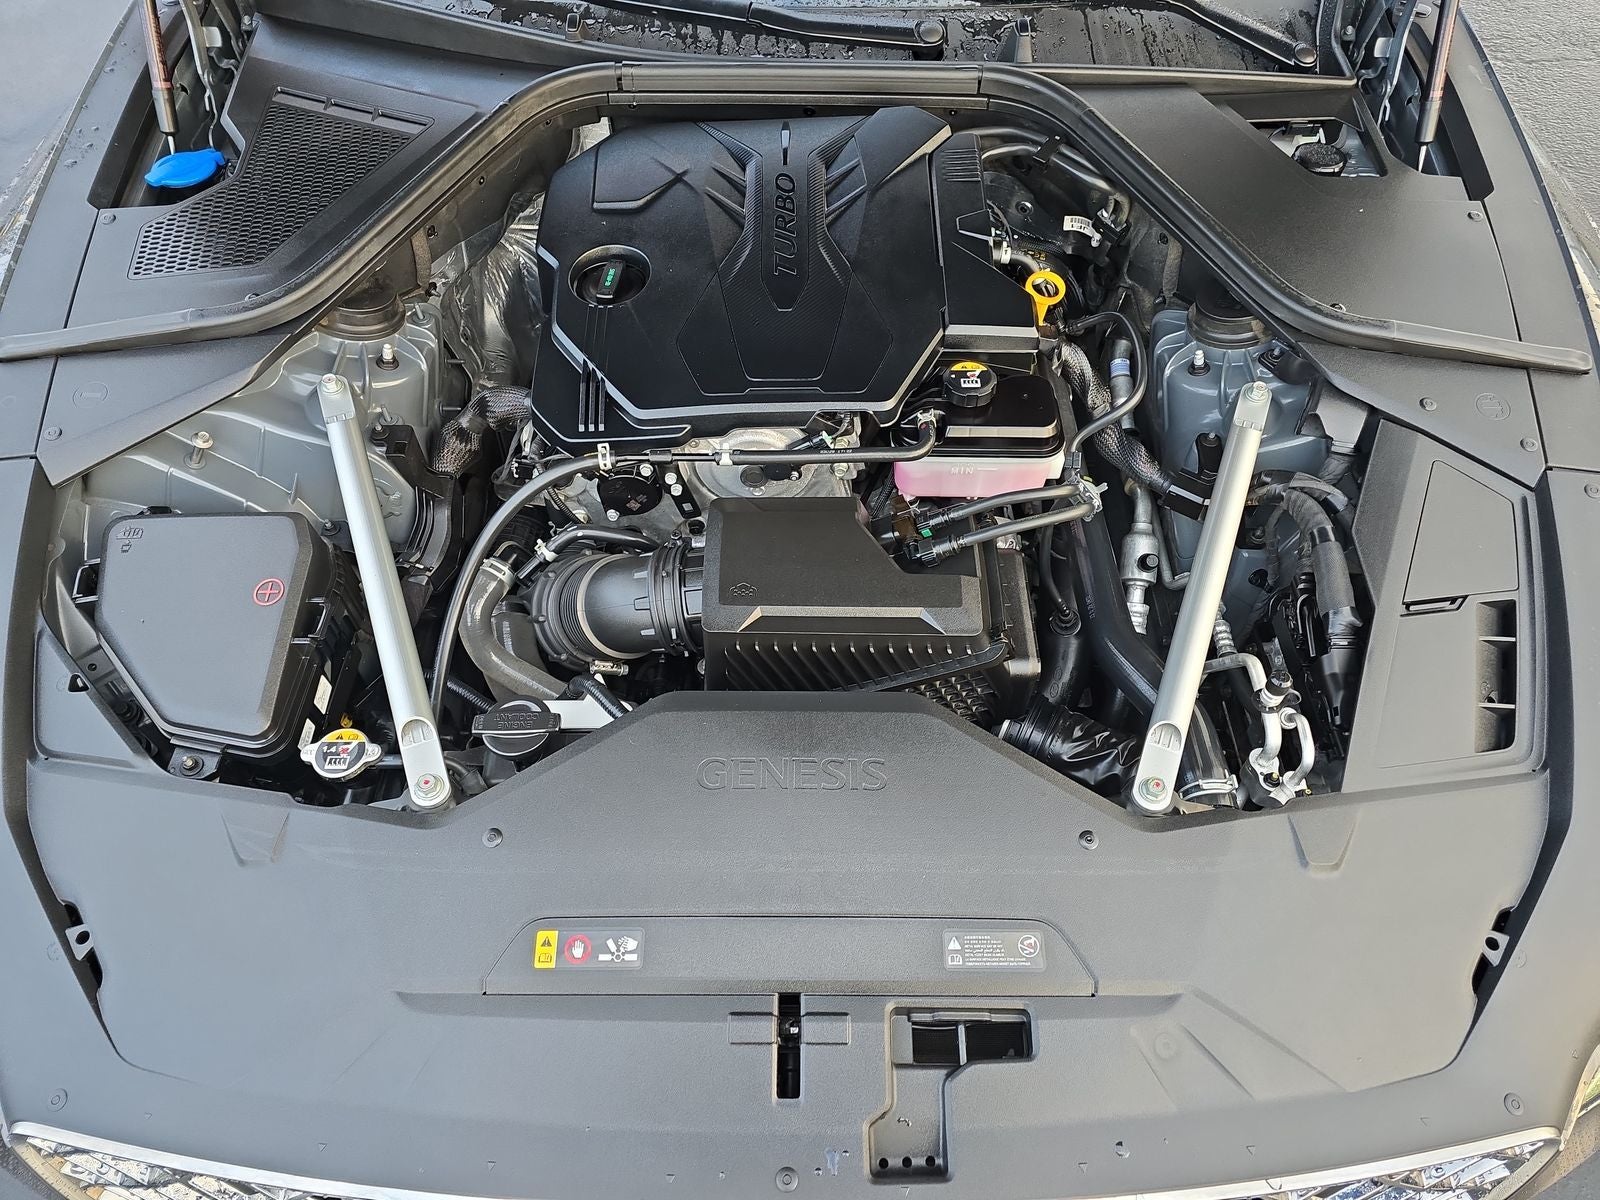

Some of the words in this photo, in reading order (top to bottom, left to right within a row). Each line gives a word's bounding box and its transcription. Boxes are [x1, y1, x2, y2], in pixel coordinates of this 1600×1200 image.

[774, 172, 797, 276] TURBO
[950, 464, 974, 474] MIN
[493, 712, 540, 721] COOLANT
[497, 720, 533, 729] ENGINE
[696, 756, 888, 791] GENESIS
